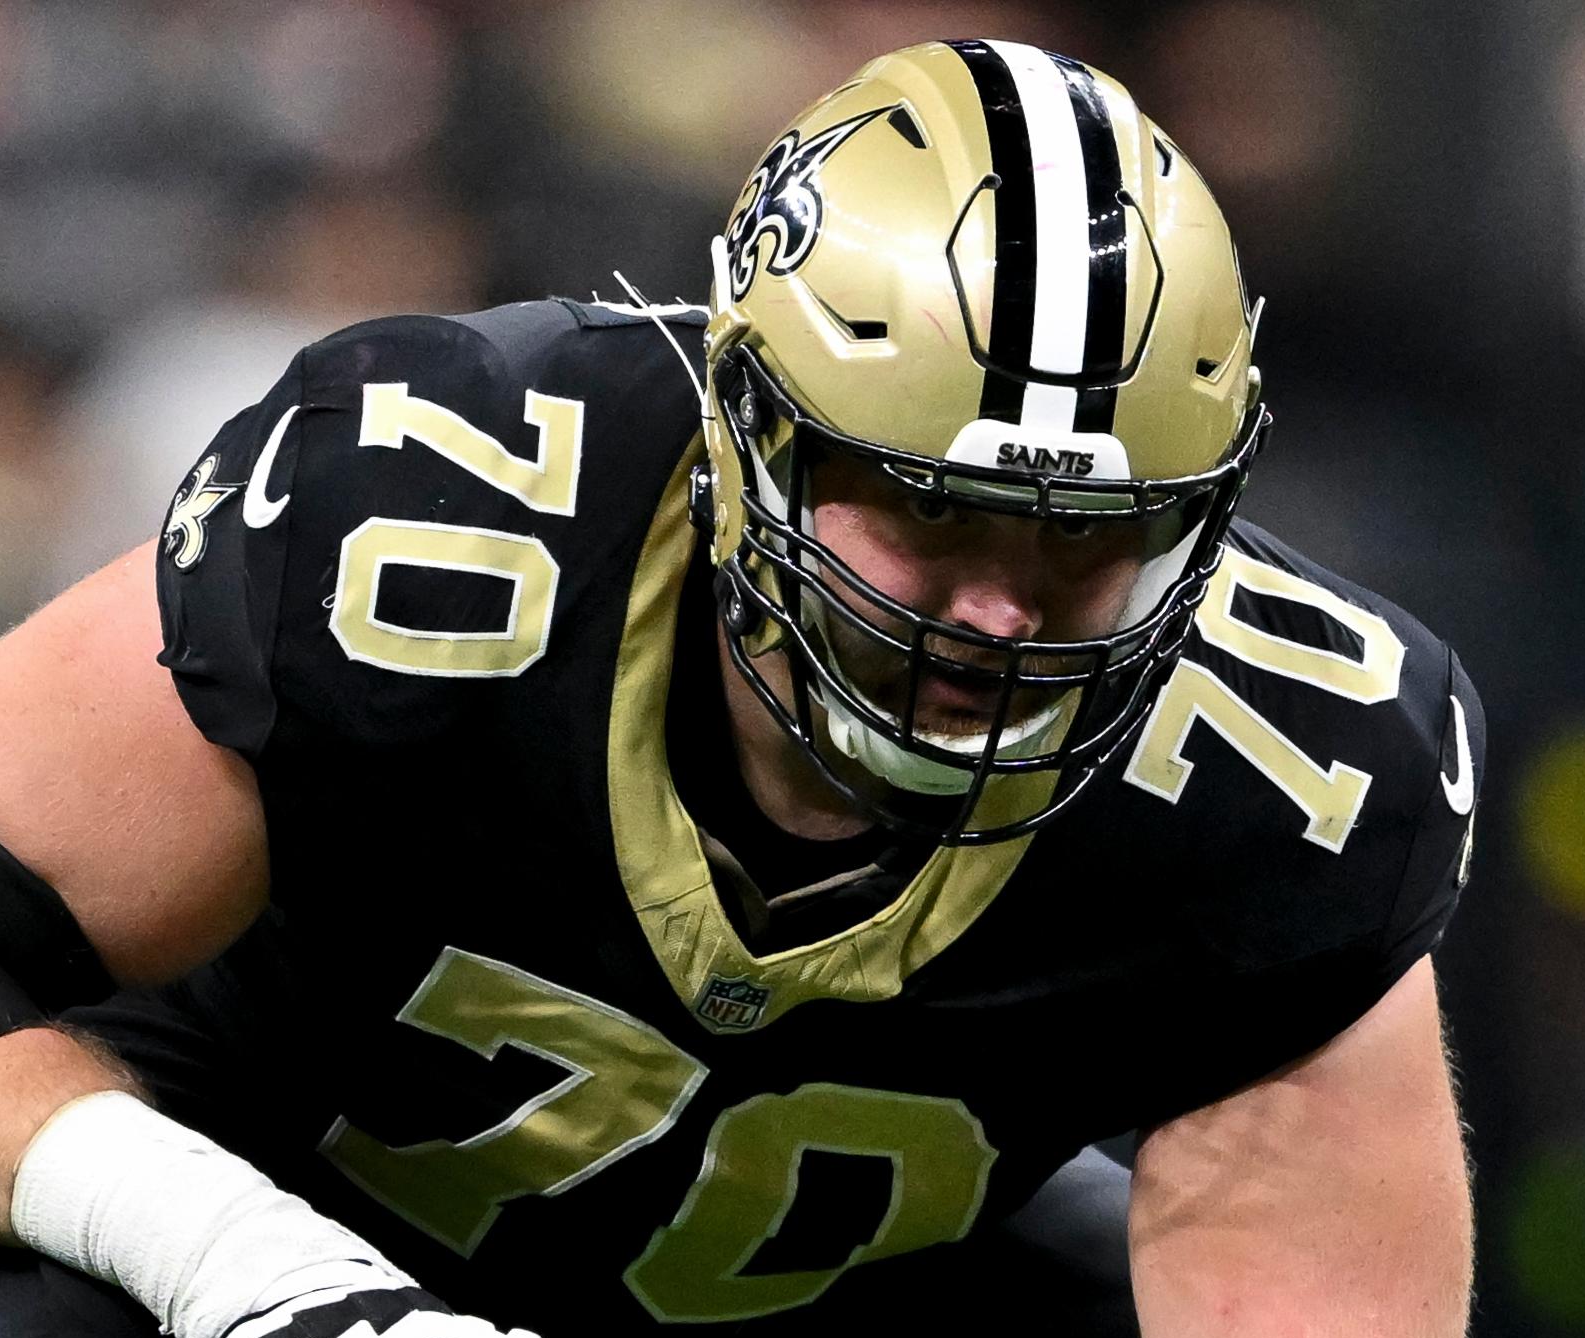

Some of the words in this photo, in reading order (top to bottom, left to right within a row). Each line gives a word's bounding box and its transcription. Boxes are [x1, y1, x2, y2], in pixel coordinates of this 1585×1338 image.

[328, 382, 584, 678] 70
[996, 442, 1095, 477] SAINTS
[1122, 543, 1407, 855] 70
[316, 945, 1001, 1325] 70
[702, 997, 755, 1025] NFL
